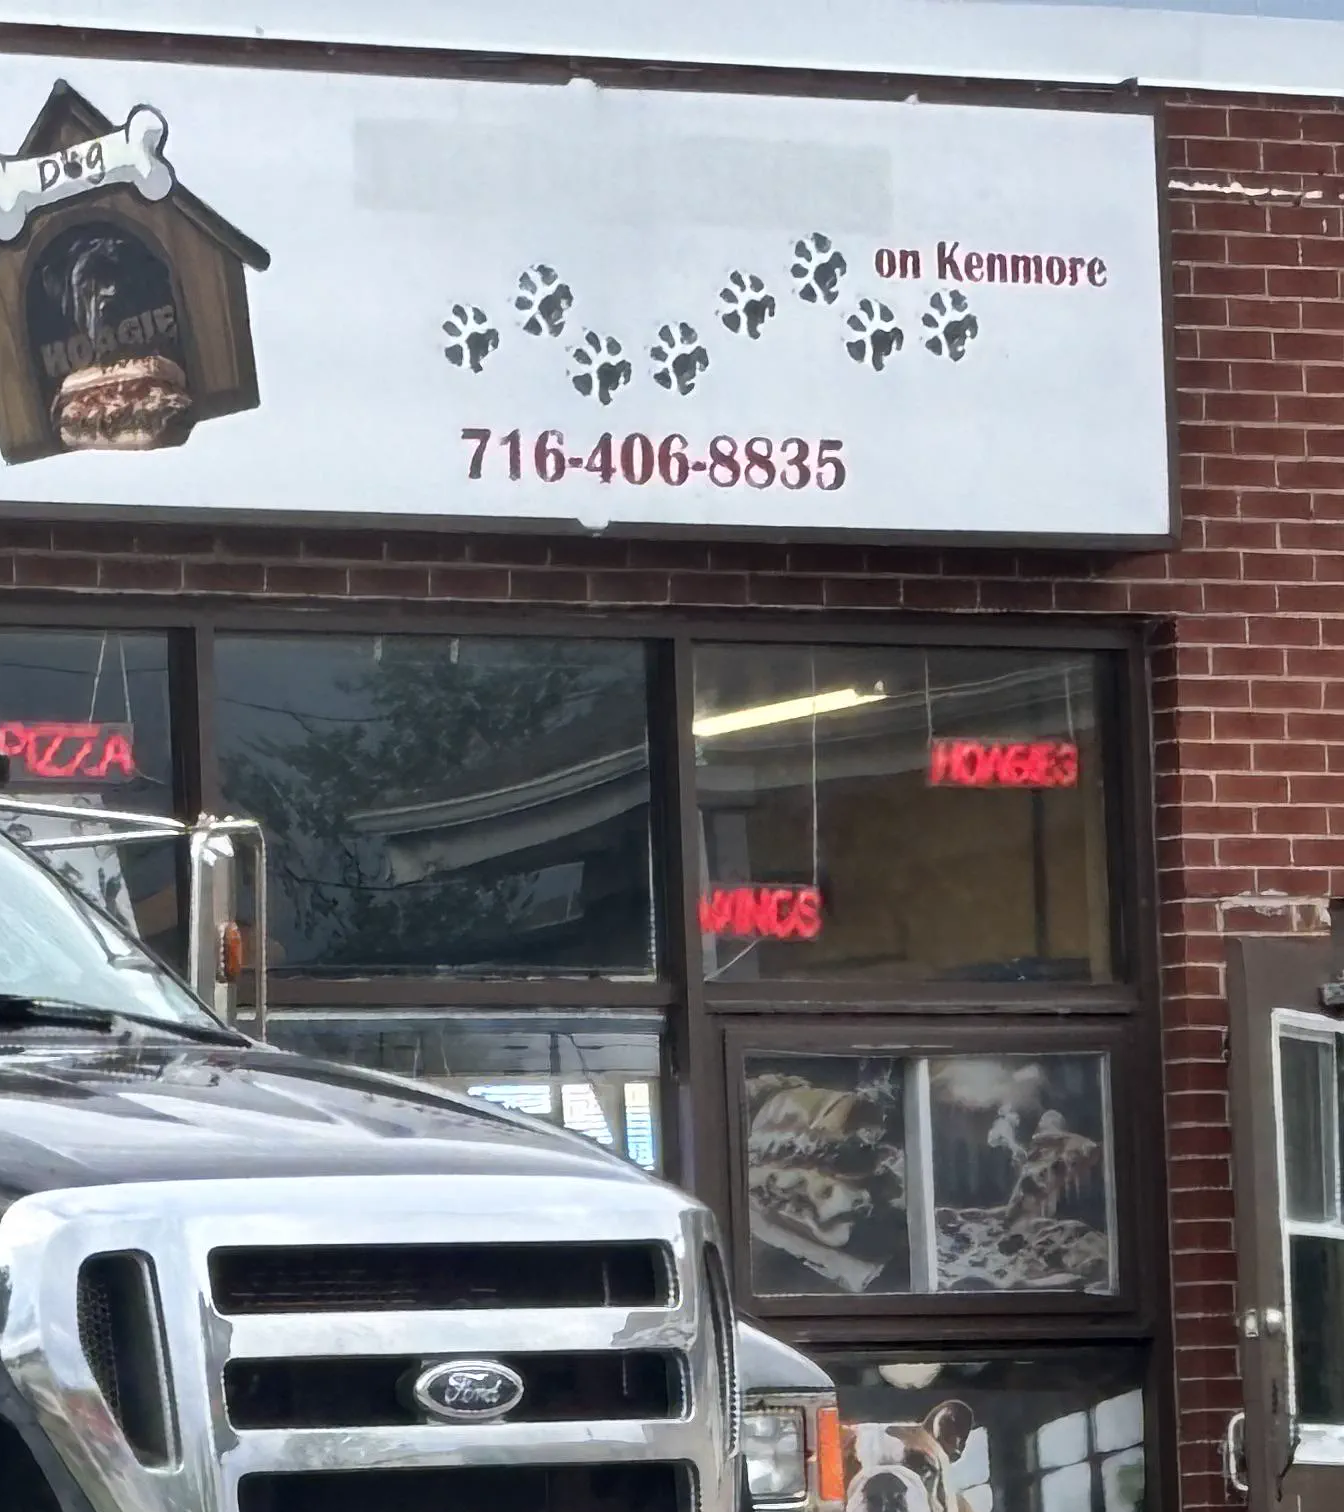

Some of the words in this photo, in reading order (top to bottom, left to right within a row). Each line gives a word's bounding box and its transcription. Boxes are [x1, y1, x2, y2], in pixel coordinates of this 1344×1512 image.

[874, 248, 921, 279] on
[936, 240, 1108, 287] Kenmore
[40, 304, 180, 379] HOAGIE
[460, 427, 847, 491] 716-406-8835
[697, 886, 822, 938] WINGS
[444, 1371, 504, 1405] Ford
